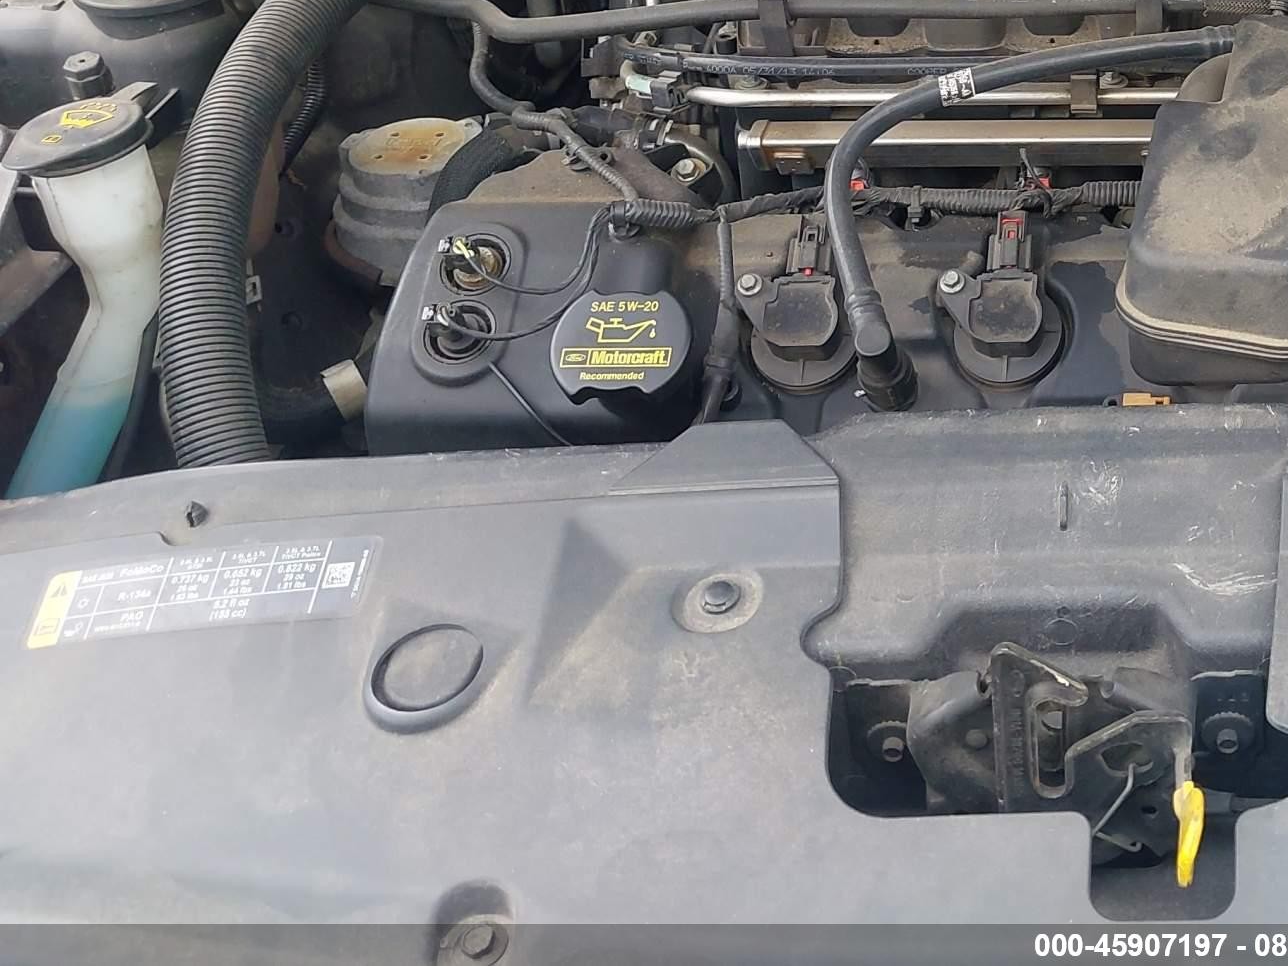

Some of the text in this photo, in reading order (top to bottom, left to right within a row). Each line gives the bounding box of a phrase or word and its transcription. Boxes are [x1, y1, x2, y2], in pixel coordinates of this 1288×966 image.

[590, 301, 659, 312] SAE 5W-20
[579, 372, 645, 381] Recommended
